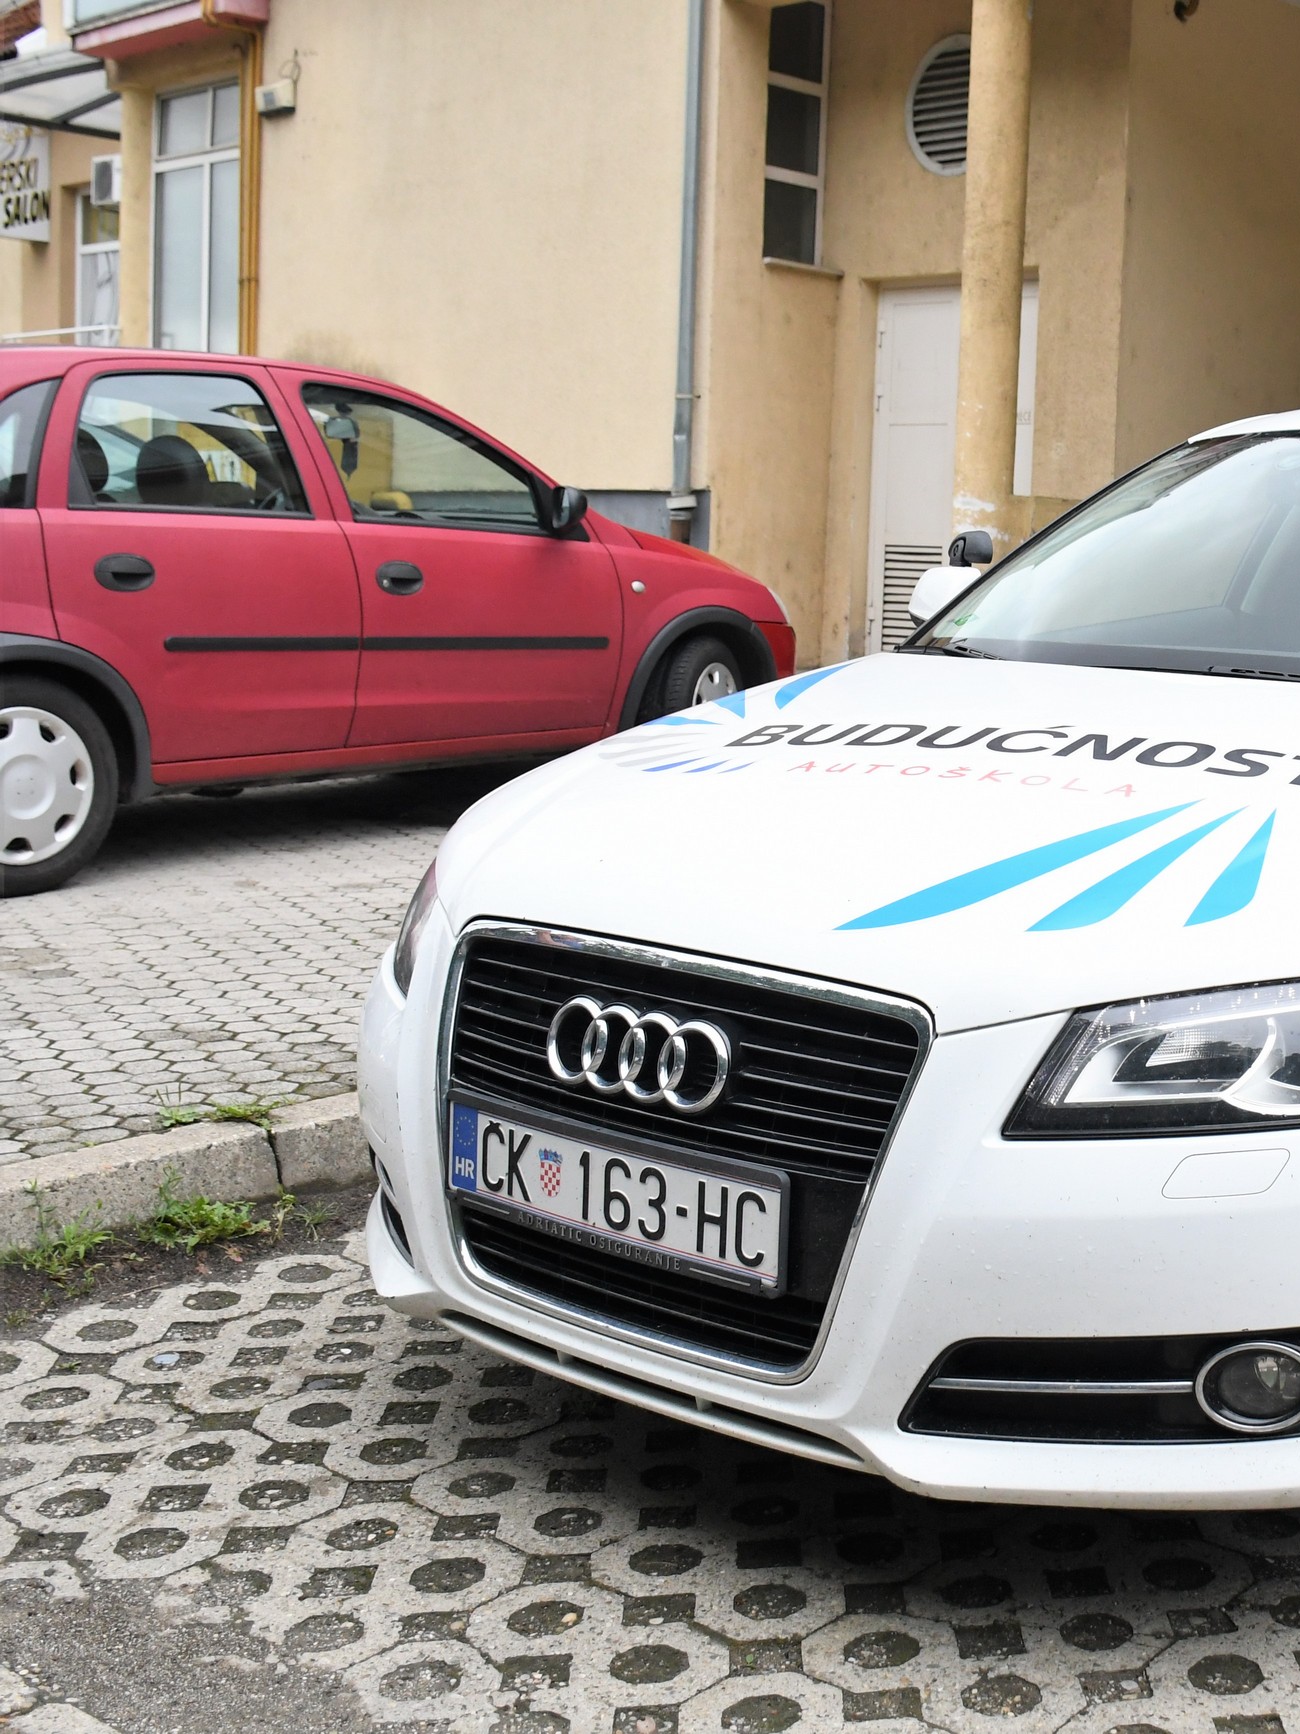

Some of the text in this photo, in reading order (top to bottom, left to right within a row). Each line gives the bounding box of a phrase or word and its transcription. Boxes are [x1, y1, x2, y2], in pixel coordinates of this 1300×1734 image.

[4, 190, 51, 229] SALON
[787, 760, 1137, 798] AUTOŠKOLA
[455, 1155, 475, 1180] HR
[481, 1120, 767, 1268] ČK 163-HC
[518, 1211, 682, 1271] ADRIATIC OSIGURANJE
